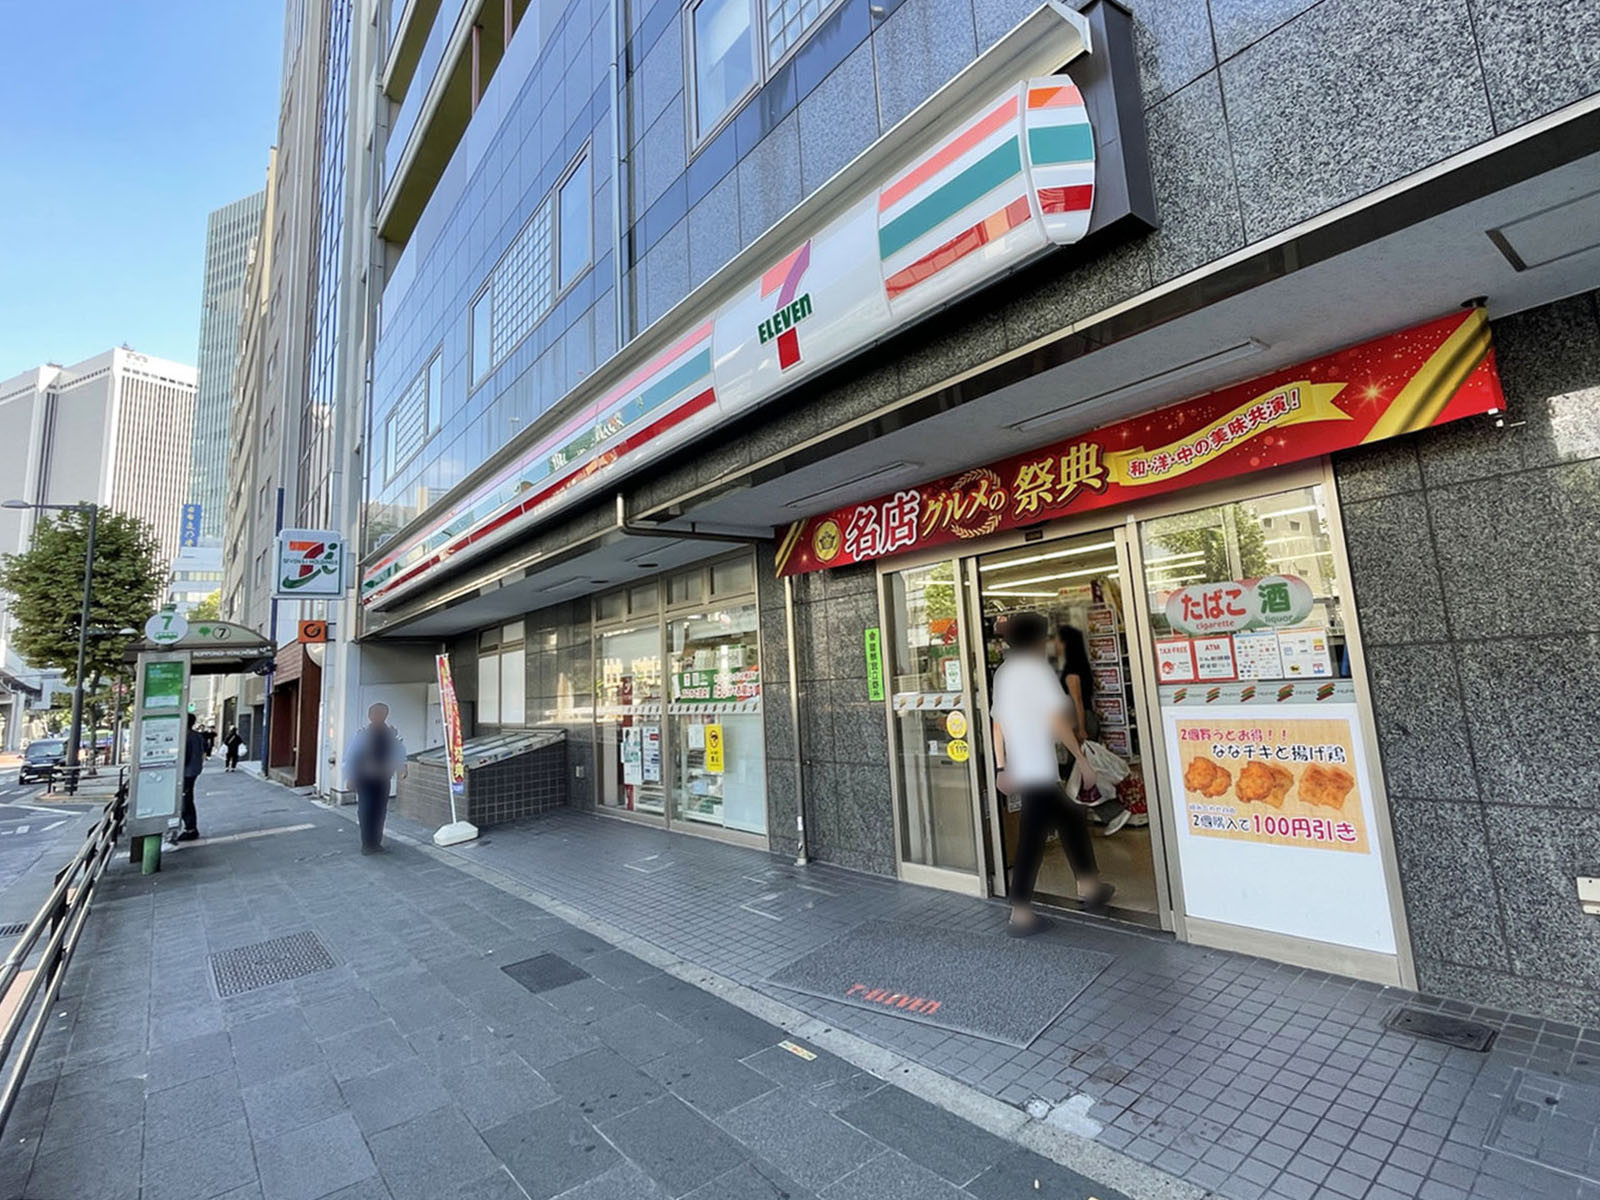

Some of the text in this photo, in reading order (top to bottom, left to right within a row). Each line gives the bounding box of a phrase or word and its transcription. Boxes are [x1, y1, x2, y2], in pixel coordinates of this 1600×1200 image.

[1180, 582, 1291, 622] たばこ 酒
[161, 615, 173, 631] 7
[1195, 620, 1235, 631] cigarette
[1264, 614, 1294, 624] liquor
